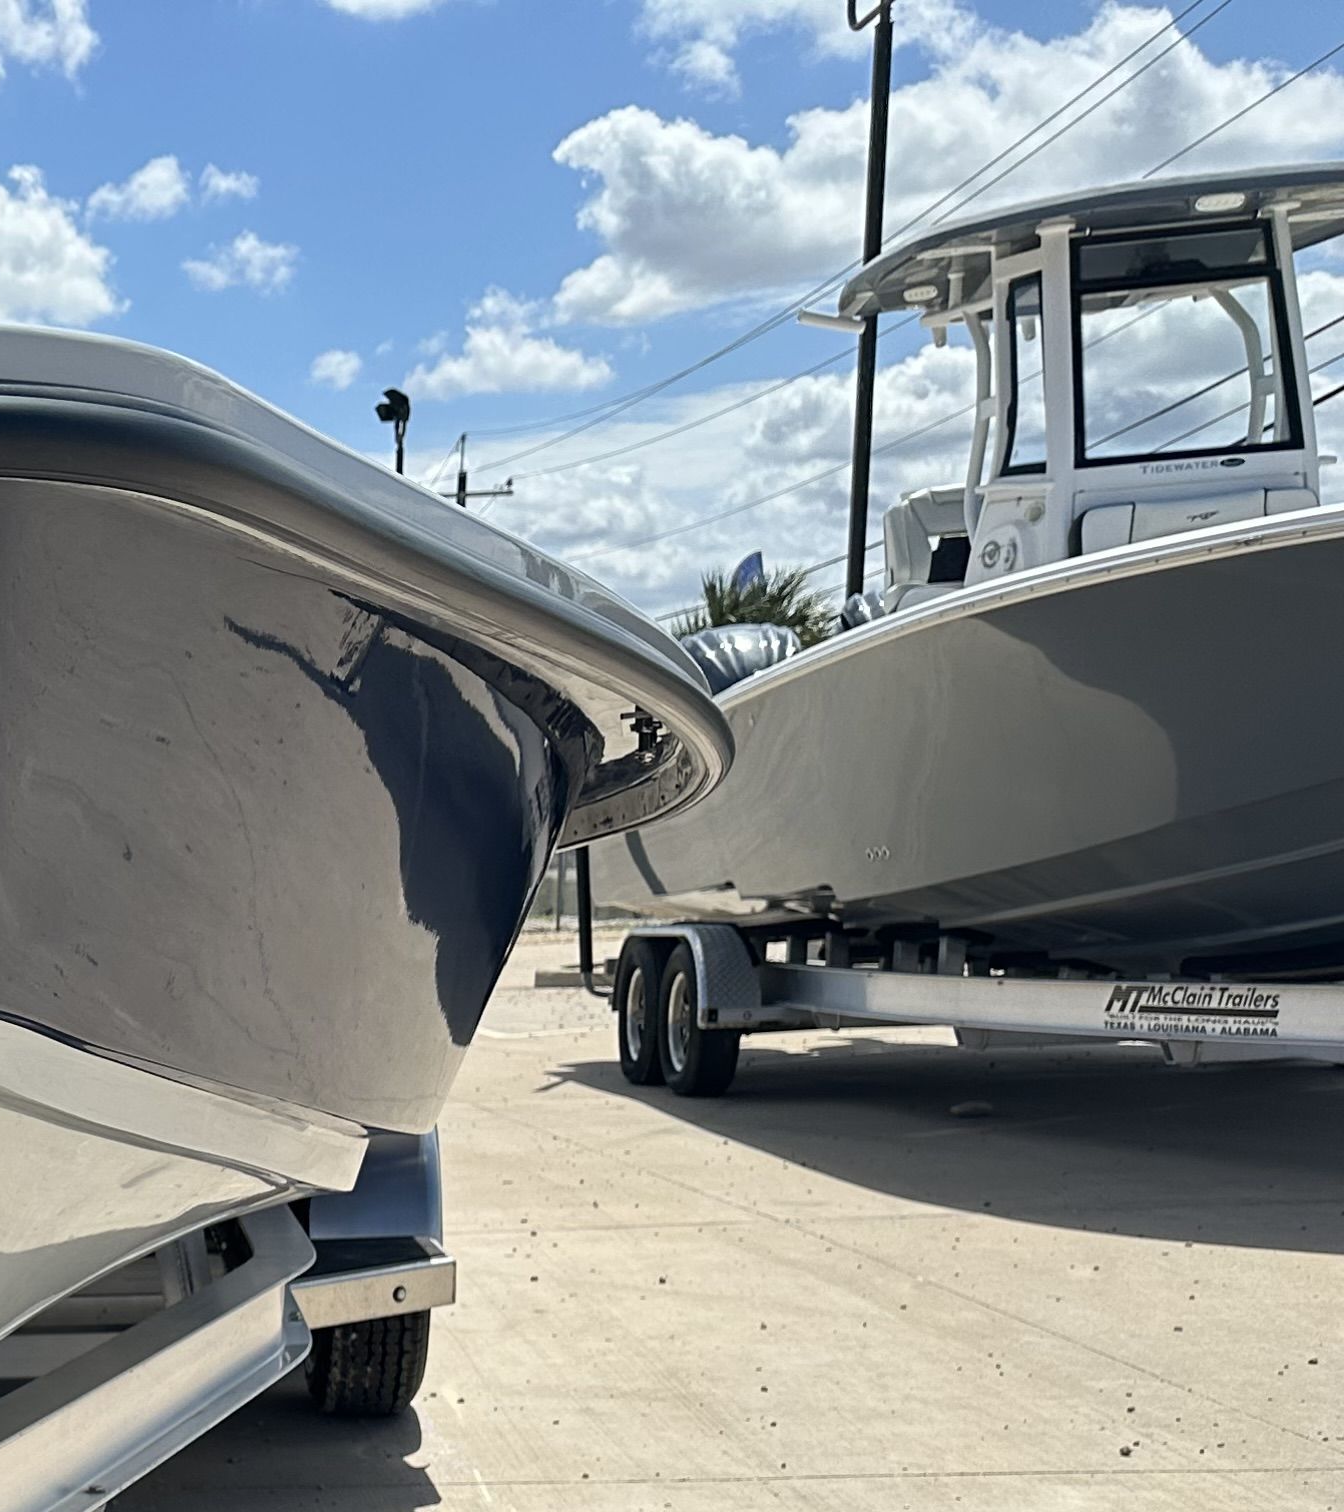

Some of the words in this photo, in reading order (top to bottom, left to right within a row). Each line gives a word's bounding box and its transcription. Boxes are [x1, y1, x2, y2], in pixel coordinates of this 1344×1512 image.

[1216, 987, 1280, 1008] Trailers
[1104, 1020, 1135, 1031] TEXAS
[1147, 1022, 1207, 1034] LOUISIANA
[1220, 1026, 1278, 1037] ALABAMA
